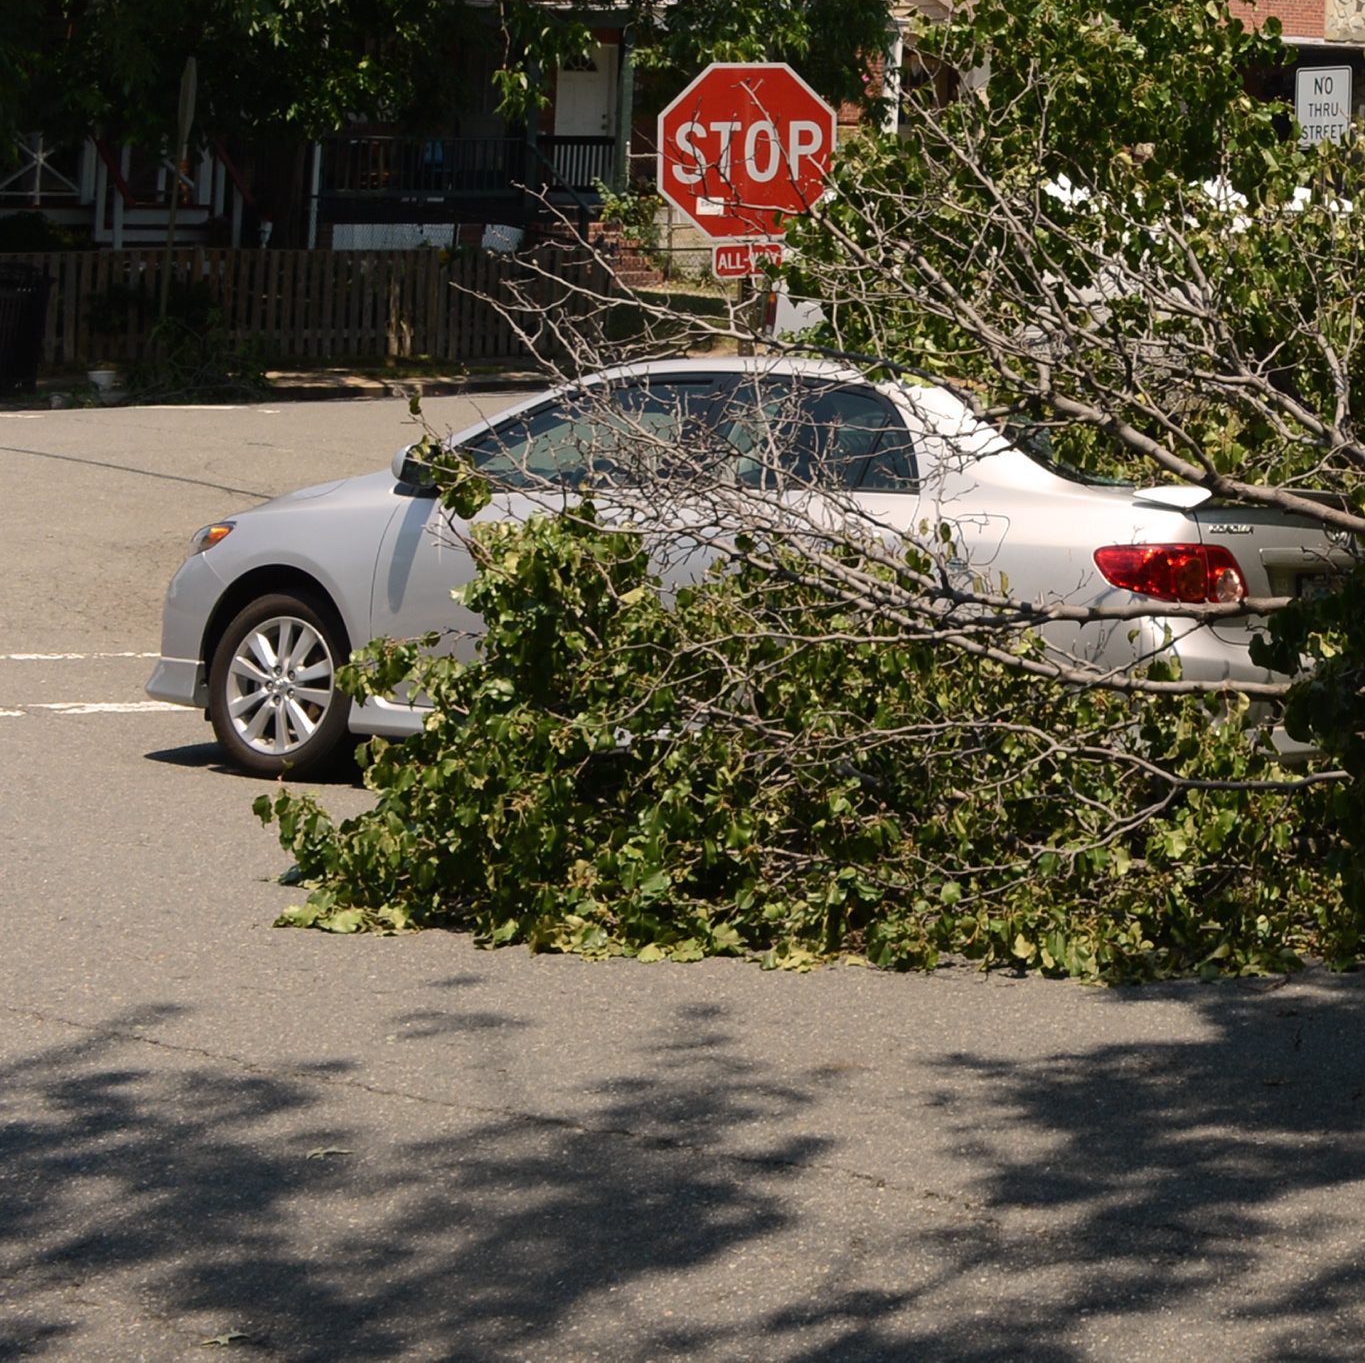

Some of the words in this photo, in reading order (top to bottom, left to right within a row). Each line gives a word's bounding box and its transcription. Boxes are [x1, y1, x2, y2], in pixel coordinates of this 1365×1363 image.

[1314, 76, 1333, 95] NO
[1308, 102, 1339, 117] THRU
[1302, 124, 1344, 140] STREET
[671, 120, 823, 184] STOP
